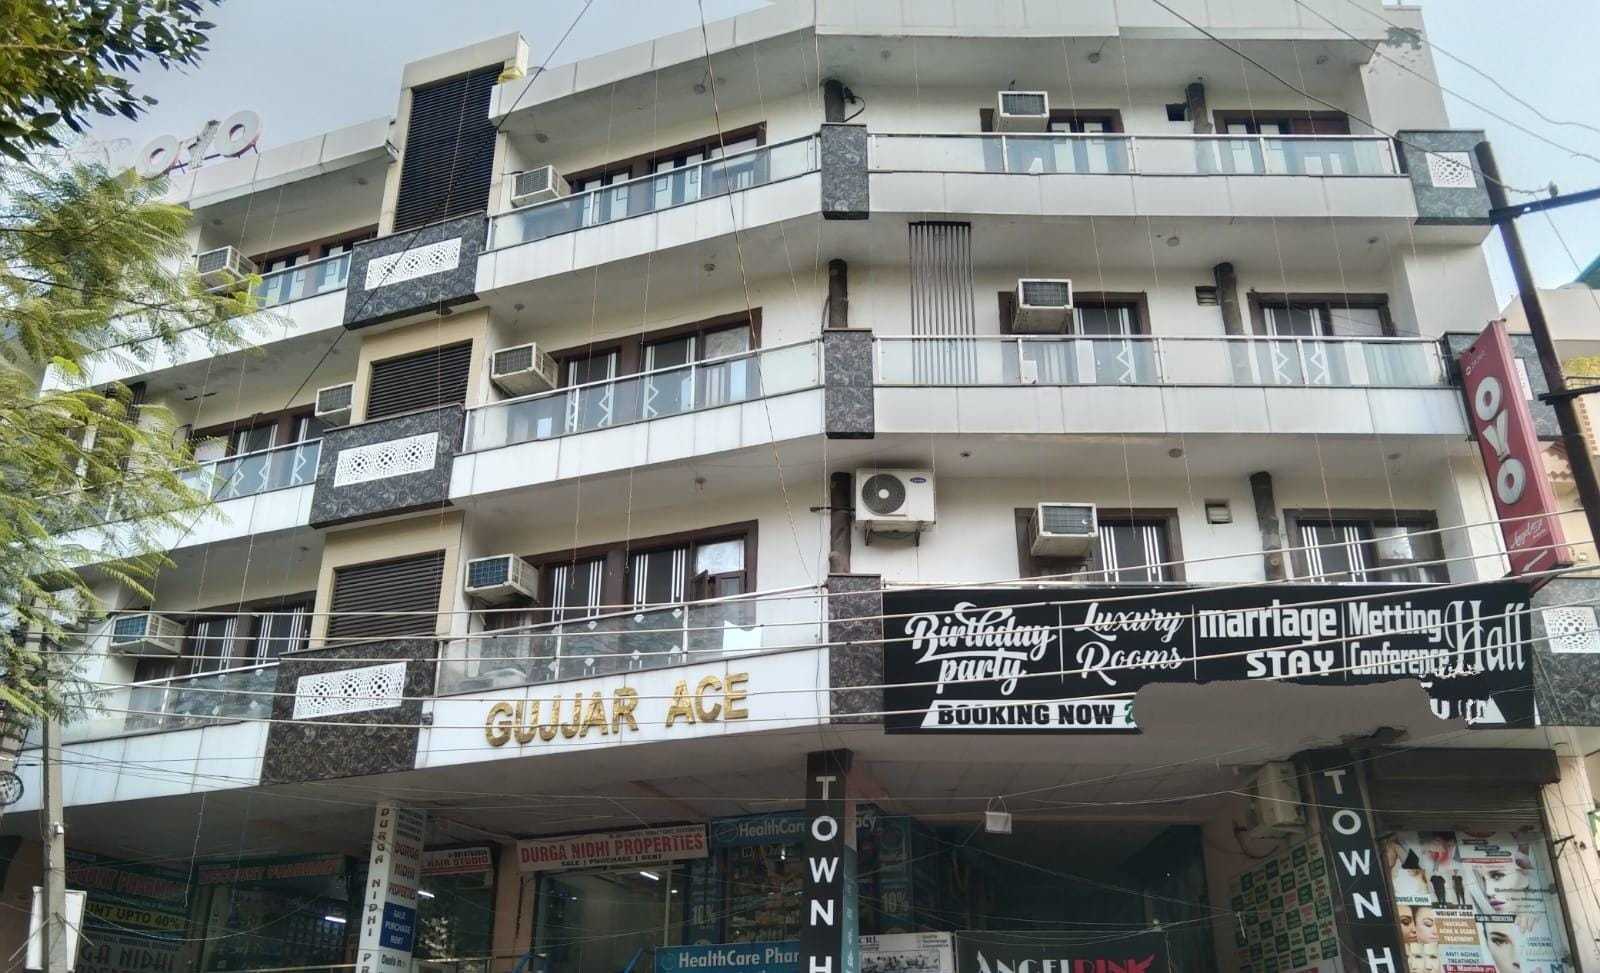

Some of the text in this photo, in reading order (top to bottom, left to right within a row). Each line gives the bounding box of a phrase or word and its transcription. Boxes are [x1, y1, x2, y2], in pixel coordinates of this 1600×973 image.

[1475, 376, 1526, 505] OYO
[904, 601, 1057, 664] Birthday
[1074, 602, 1185, 642] Luxury
[1200, 600, 1337, 644] marriage
[1350, 602, 1441, 642] Metting
[1445, 600, 1527, 673] Hall
[935, 648, 1028, 696] party
[1076, 641, 1184, 686] Rooms
[1247, 651, 1336, 677] STAY
[1350, 642, 1450, 676] Conference
[485, 672, 749, 746] GUJJAR ACE
[938, 703, 1116, 725] BOOKING NOW
[374, 808, 390, 865] DURGA
[521, 834, 704, 864] DURGA NIDHI PROPERTIES
[808, 776, 838, 927] TOWN
[1324, 769, 1382, 920] TOWN
[367, 879, 381, 938] NIDHI
[679, 948, 800, 968] HealthCare Phar
